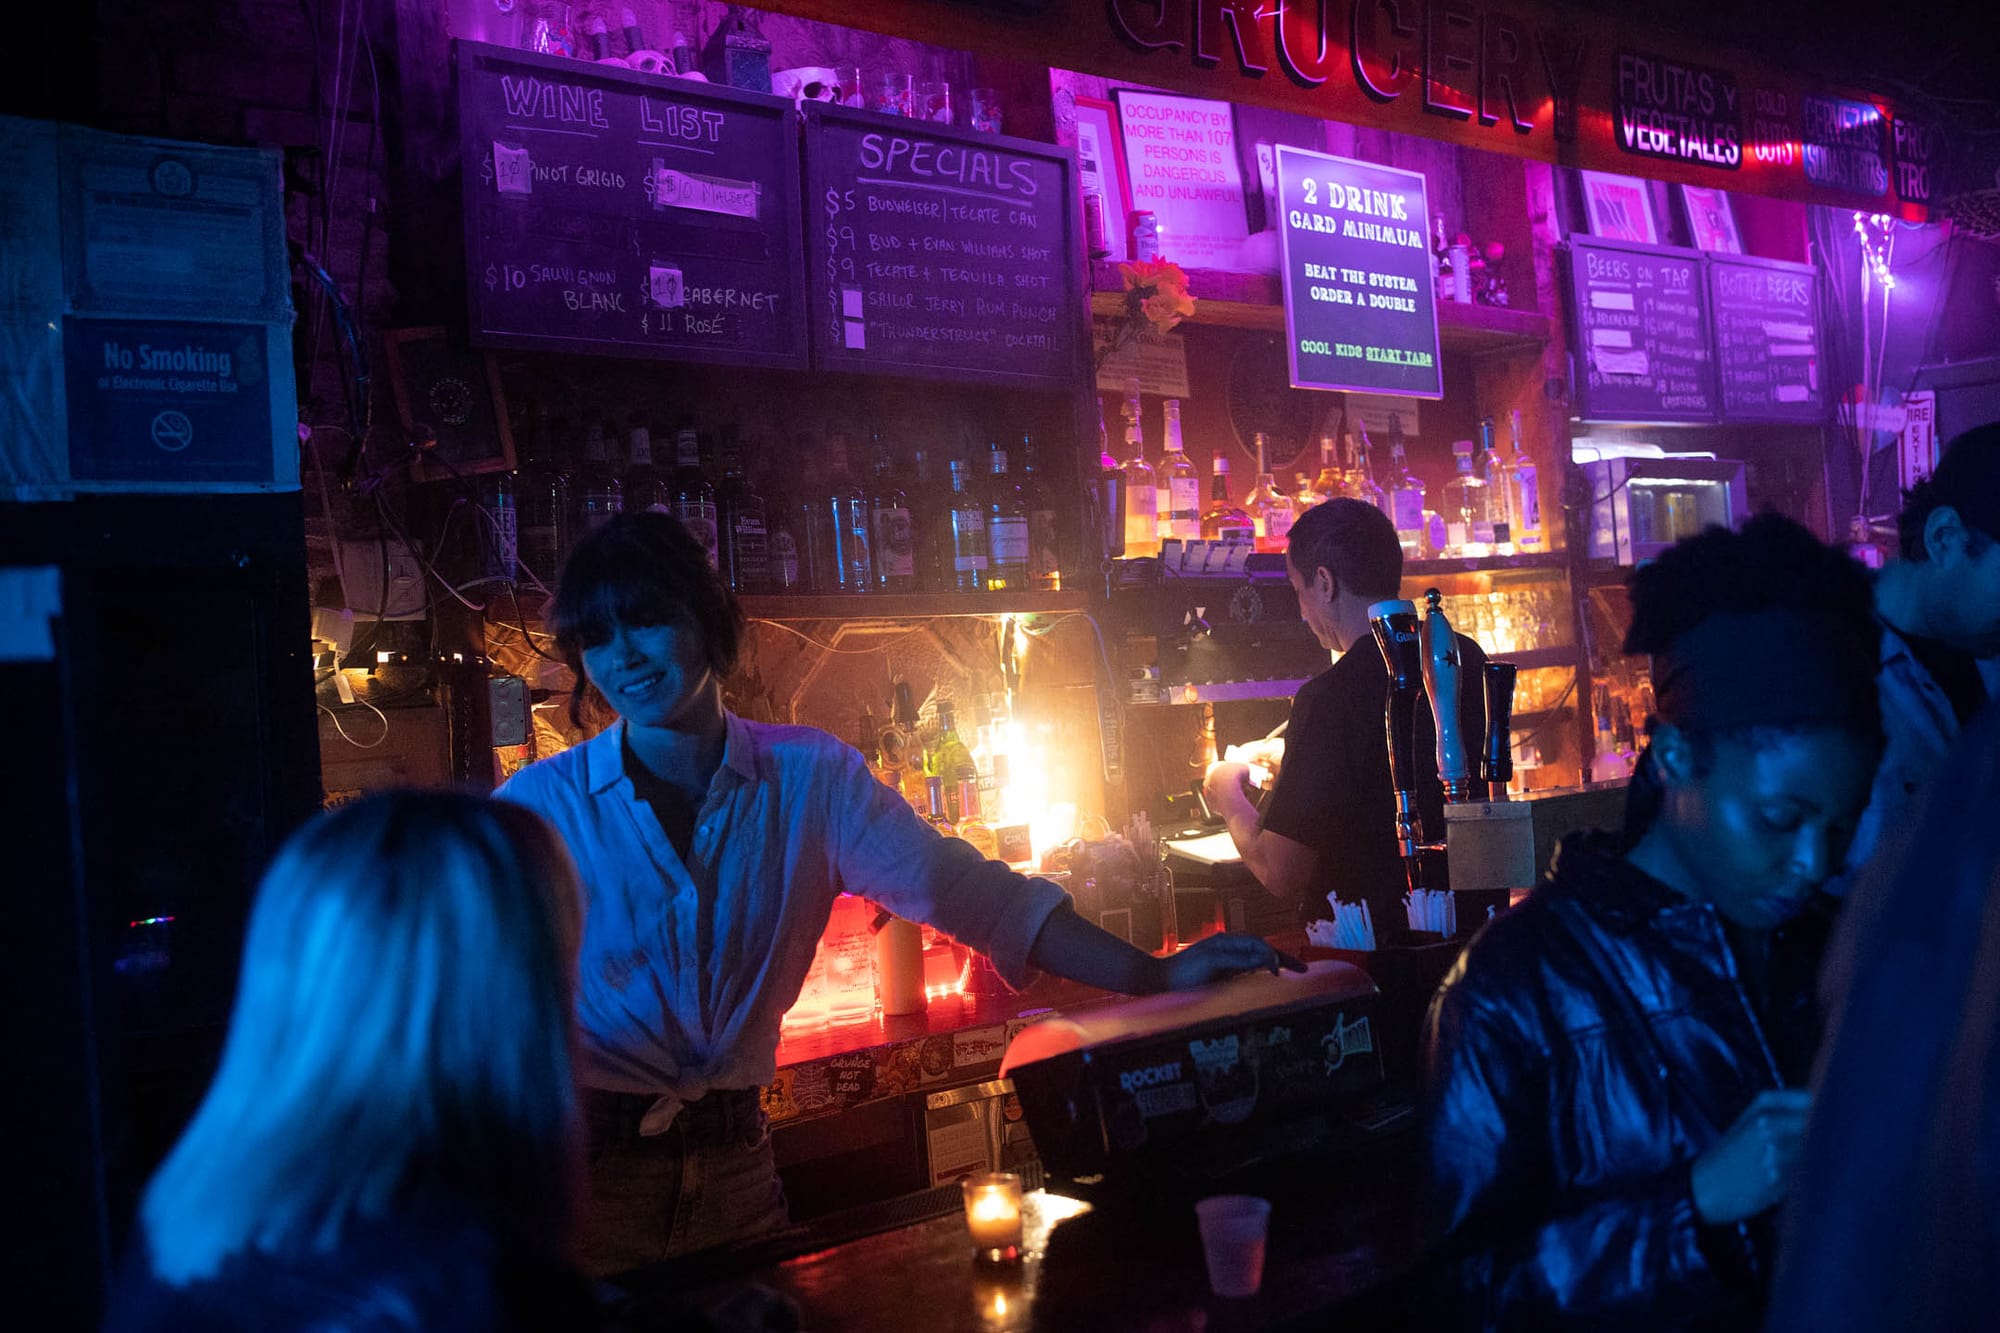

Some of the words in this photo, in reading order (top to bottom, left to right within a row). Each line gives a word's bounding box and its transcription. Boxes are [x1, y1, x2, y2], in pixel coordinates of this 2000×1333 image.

[1618, 54, 1716, 116] FRUTAS
[1719, 83, 1737, 112] Y
[500, 74, 610, 129] WINE
[639, 94, 725, 142] LIST
[1125, 103, 1208, 125] OCCUPANCY
[1211, 112, 1228, 127] BY
[1754, 87, 1788, 117] COLD
[1125, 123, 1166, 140] MORE
[1168, 127, 1204, 144] THAN
[1207, 129, 1232, 147] 107
[1620, 104, 1740, 166] VEGETALES
[1753, 117, 1794, 166] CUTS
[860, 133, 1038, 196] SPECIALS
[1144, 143, 1208, 163] PERSONS
[1210, 150, 1222, 164] IS
[528, 160, 569, 184] PINOT
[576, 165, 627, 189] GRIGIO
[1143, 164, 1227, 184] DANGEROUS
[1135, 184, 1166, 198] AND
[1168, 185, 1240, 203] UNLAWFUL
[1302, 178, 1318, 205] 2
[1328, 181, 1409, 222] DRINK
[1009, 211, 1038, 229] CAN
[1290, 210, 1337, 234] CARD
[1342, 219, 1424, 249] MINIMUM
[868, 232, 902, 253] BUD
[923, 236, 956, 252] EVAN
[960, 239, 1016, 260] WILLIAMS
[1021, 245, 1052, 263] SHOT
[529, 264, 617, 286] SAUVIGNON
[866, 261, 920, 281] TECATE
[939, 267, 1006, 287] TEQUILA
[1015, 274, 1052, 290] SHOT
[1304, 262, 1338, 281] BEAT
[1340, 268, 1367, 285] THE
[1368, 272, 1419, 293] SYSTEM
[1587, 252, 1630, 280] BEERS
[1637, 266, 1653, 280] ON
[1660, 267, 1690, 288] TAP
[563, 289, 627, 313] BLANC
[1310, 285, 1353, 305] ORDER
[1356, 292, 1367, 307] A
[1368, 293, 1416, 313] DOUBLE
[1767, 275, 1809, 306] BEERS
[867, 290, 918, 311] SAILOR
[924, 294, 968, 318] JERRY
[975, 297, 1009, 319] RUM
[1012, 302, 1058, 323] PUNCH
[103, 341, 133, 371] No
[138, 344, 232, 377] Smoking
[1301, 340, 1332, 357] COOL
[1335, 344, 1363, 359] KIDS
[1366, 347, 1402, 364] START
[1405, 350, 1433, 367] TABS
[112, 377, 166, 394] Electronic
[168, 378, 218, 395] Cigarette
[830, 1055, 871, 1070] GRUNGE
[839, 1069, 862, 1081] NOT
[836, 1081, 861, 1093] DEAD
